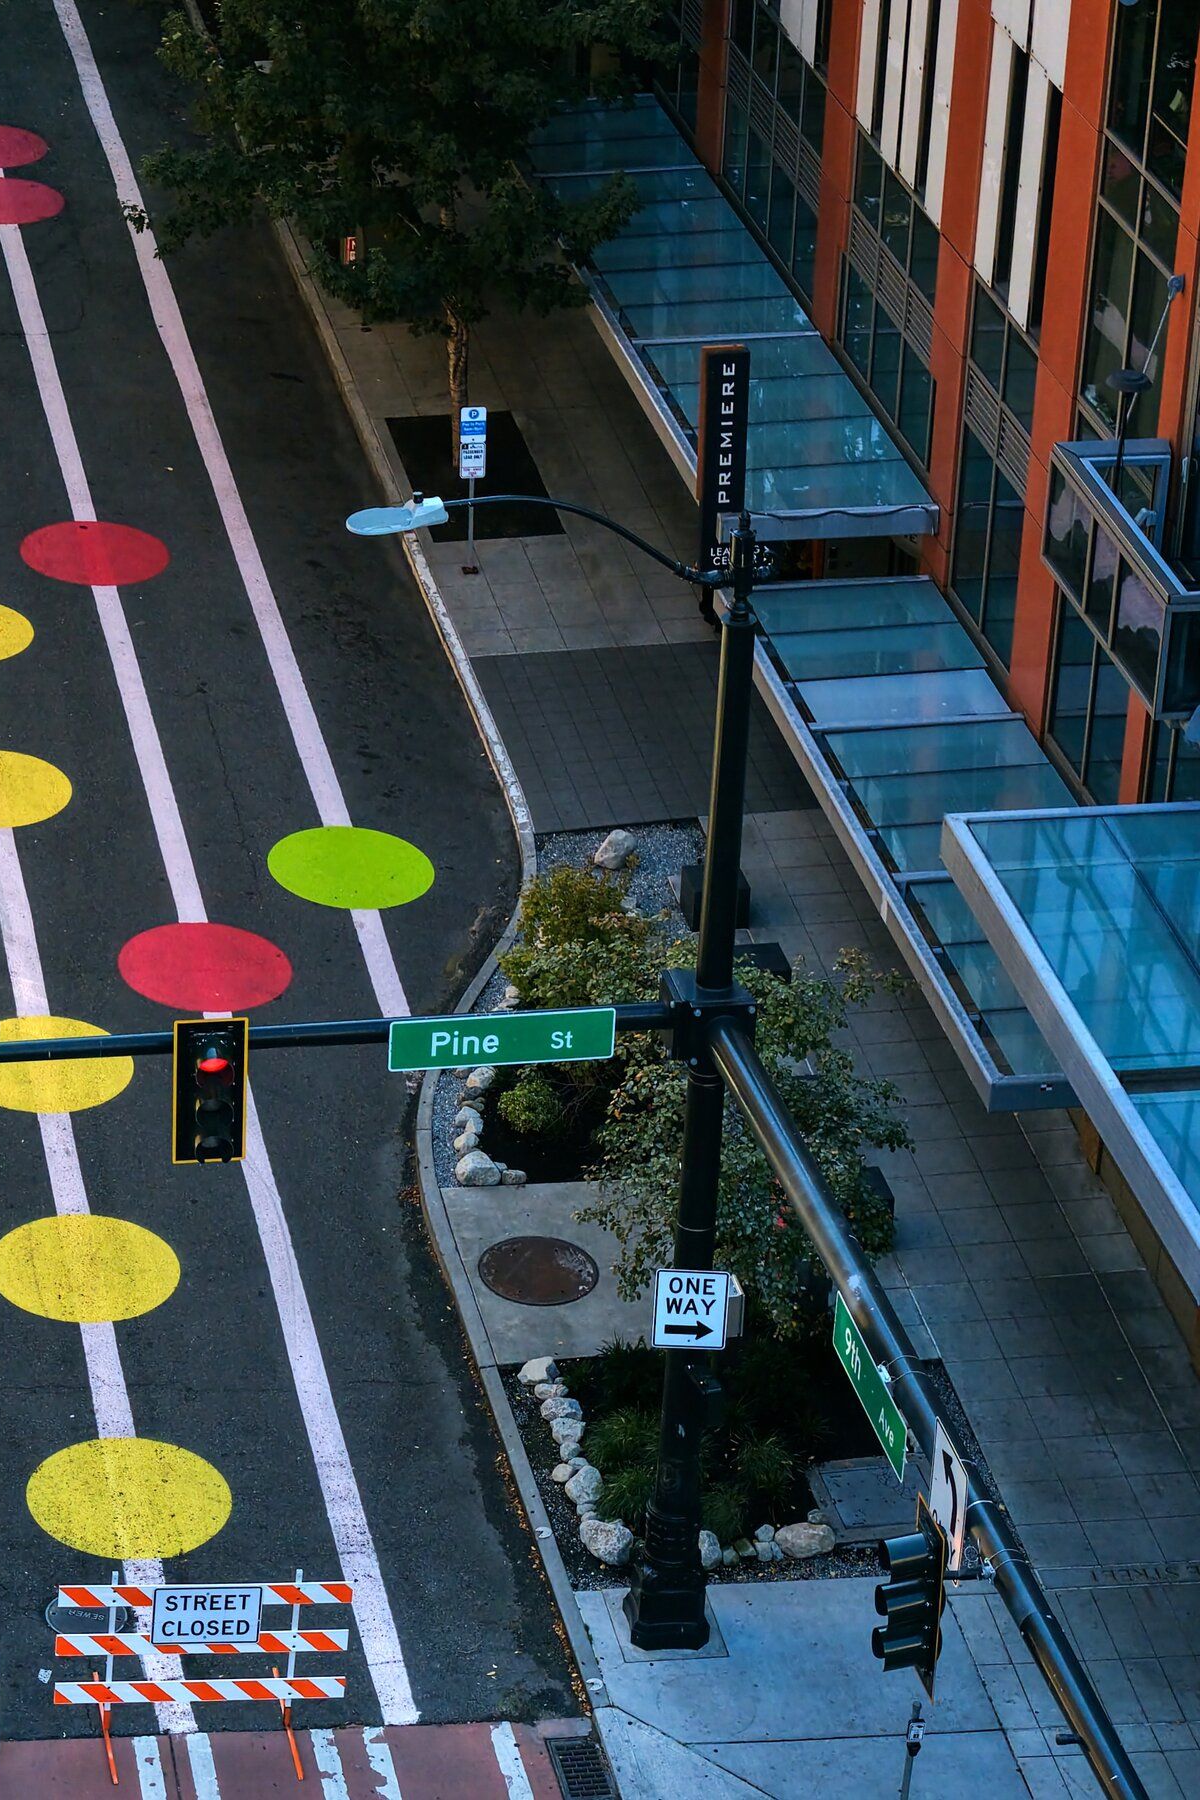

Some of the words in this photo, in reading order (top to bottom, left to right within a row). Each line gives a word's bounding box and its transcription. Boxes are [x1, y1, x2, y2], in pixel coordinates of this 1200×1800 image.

[718, 362, 736, 504] PREMIERE
[431, 1030, 500, 1057] Pine
[550, 1030, 573, 1049] St
[669, 1276, 716, 1295] ONE
[666, 1297, 717, 1316] WAY
[844, 1327, 862, 1381] 9th
[877, 1407, 895, 1448] Ave
[165, 1594, 251, 1612] STREET
[67, 1608, 105, 1621] SEWER
[161, 1619, 250, 1637] CLOSED
